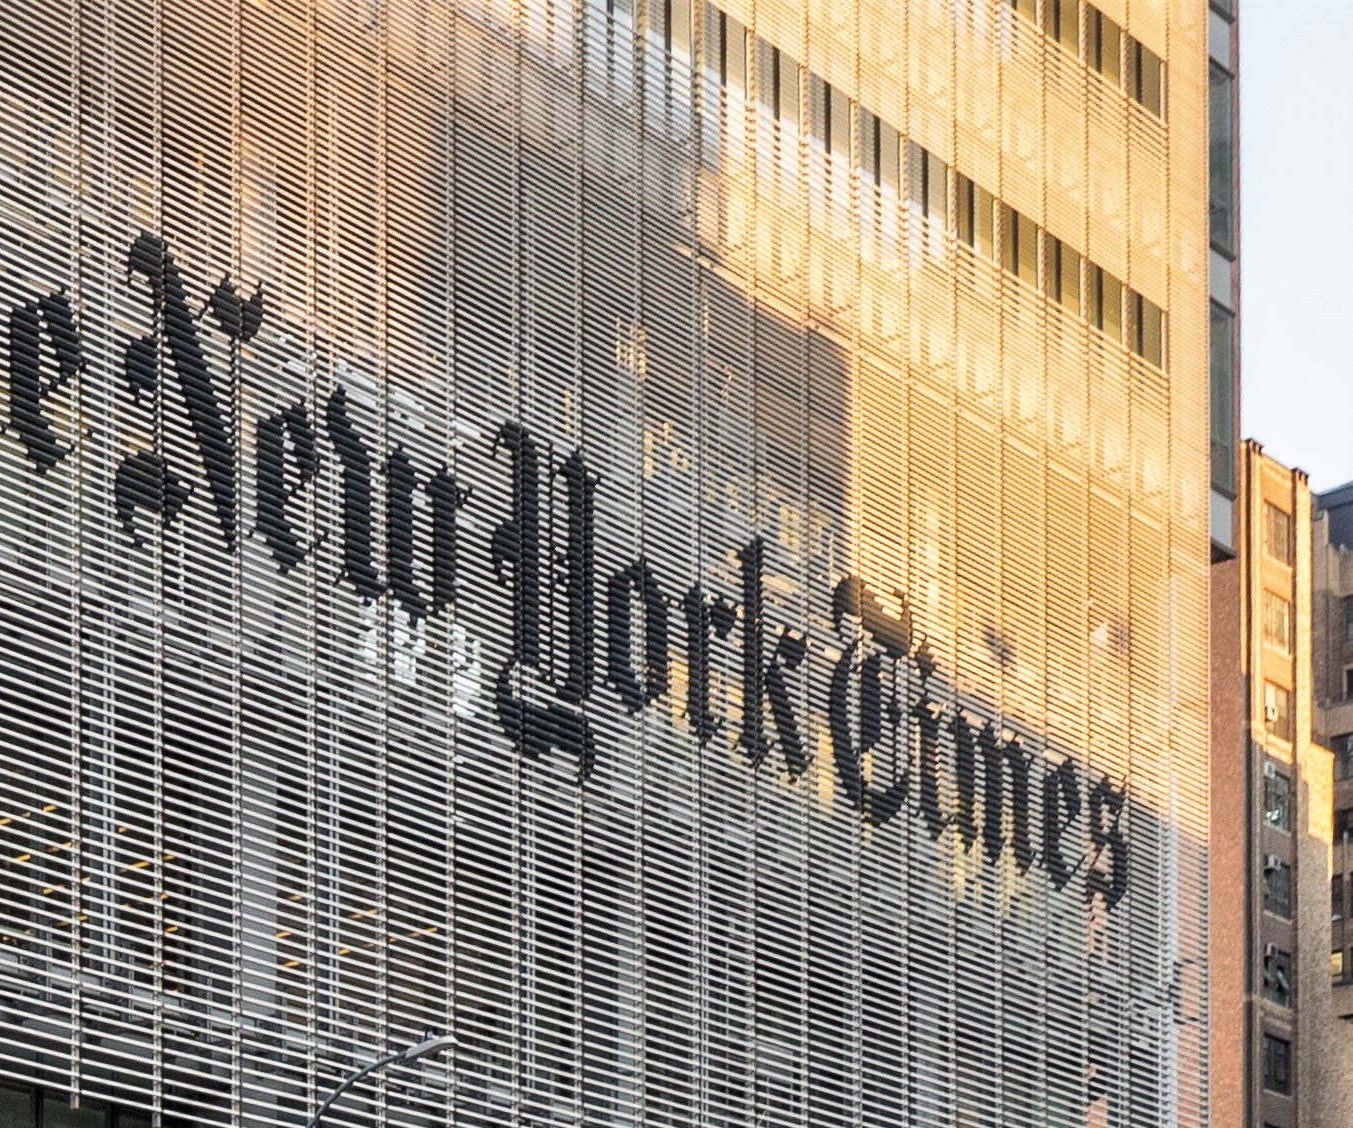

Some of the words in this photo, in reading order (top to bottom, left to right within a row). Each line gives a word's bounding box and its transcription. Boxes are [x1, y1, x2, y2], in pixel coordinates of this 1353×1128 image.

[114, 230, 475, 624] New
[492, 420, 811, 788] York
[830, 572, 1129, 909] Times
